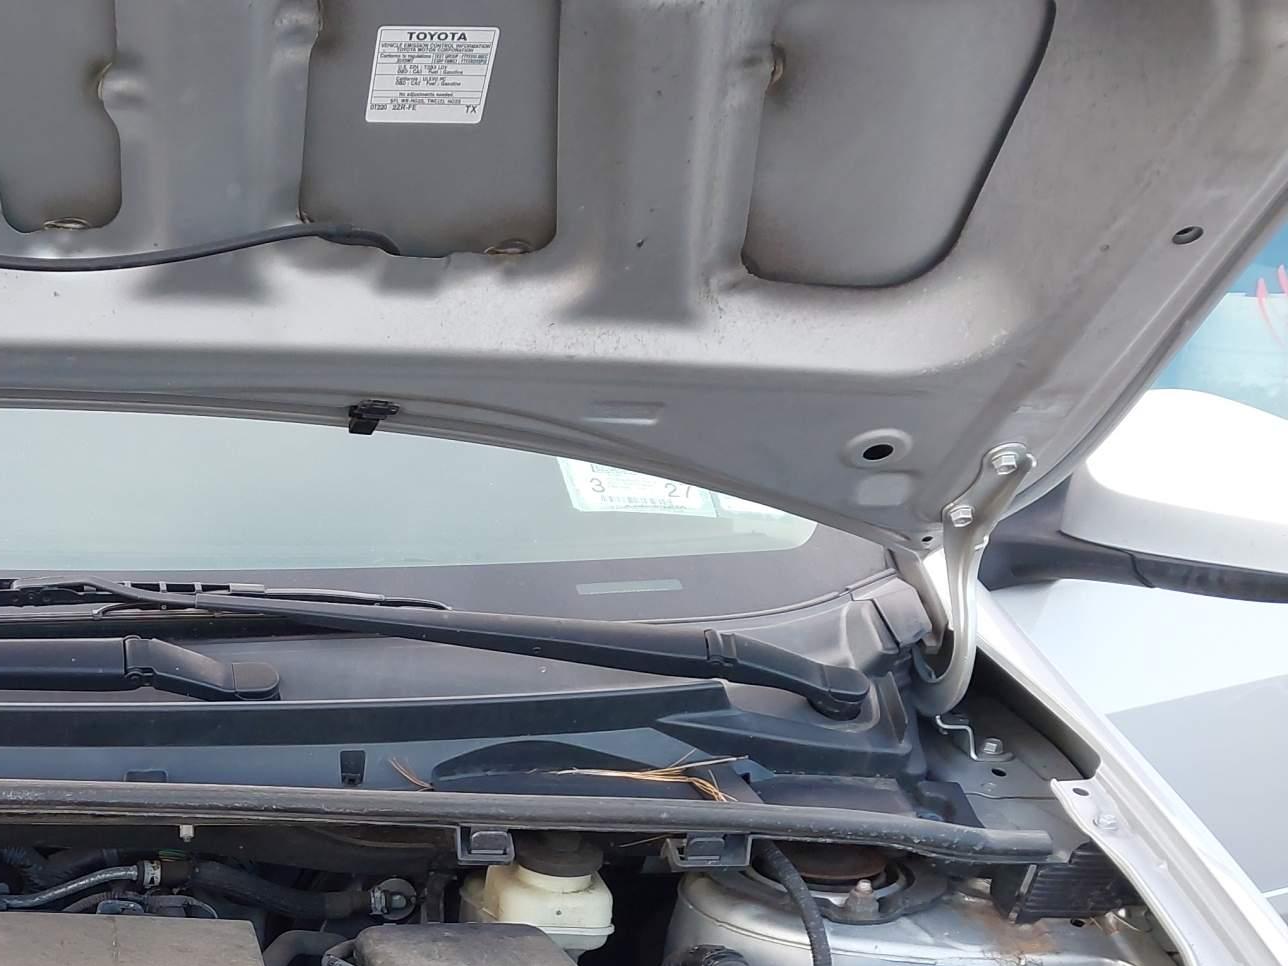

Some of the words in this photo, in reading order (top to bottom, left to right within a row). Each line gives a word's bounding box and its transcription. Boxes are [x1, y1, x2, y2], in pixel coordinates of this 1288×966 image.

[407, 32, 467, 41] TOYOTA
[465, 105, 478, 113] TX
[589, 477, 606, 493] 3
